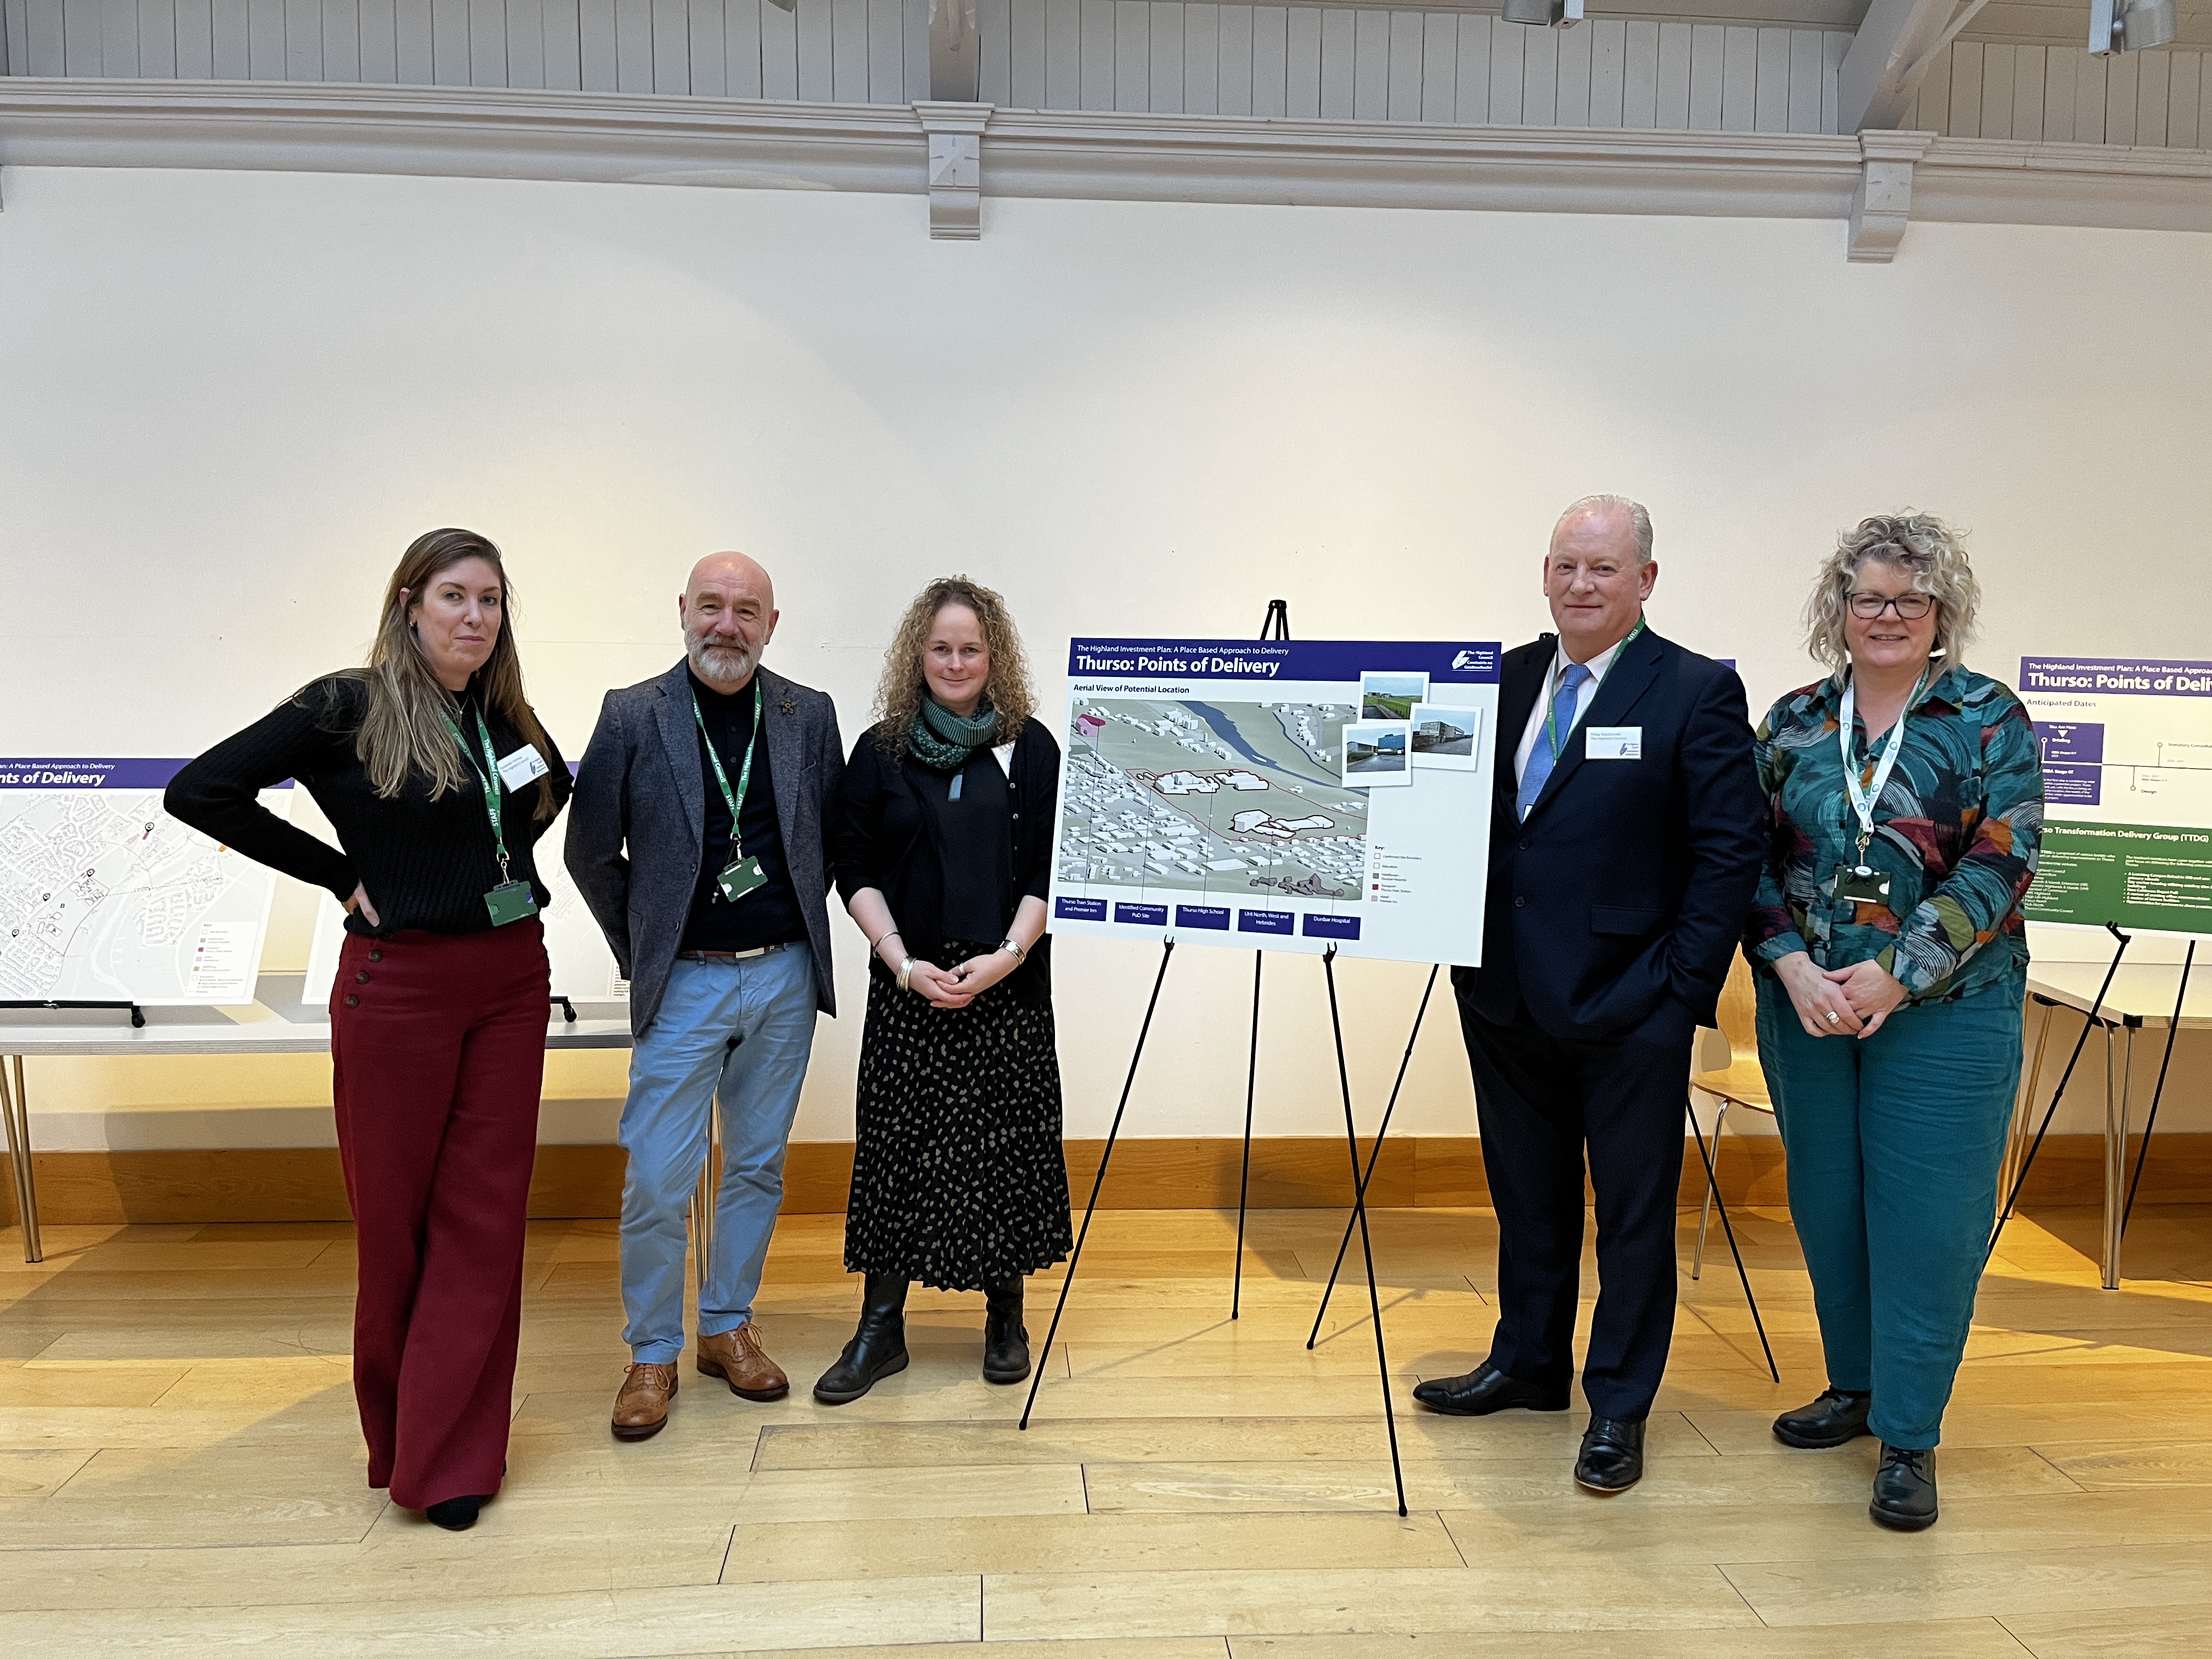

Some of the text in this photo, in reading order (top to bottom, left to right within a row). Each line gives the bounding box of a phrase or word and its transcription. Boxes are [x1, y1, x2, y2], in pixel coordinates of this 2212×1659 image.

[1627, 628, 1638, 642] STAFF
[1219, 647, 1252, 655] Approach
[1261, 647, 1289, 656] Delivery
[1076, 655, 1280, 678] Thurso: Points of Delivery
[2028, 672, 2212, 691] Thurso: Points of Deli
[485, 748, 498, 773] Highland
[741, 747, 753, 781] The Highland
[22, 771, 41, 783] of
[41, 771, 105, 787] Delivery
[715, 763, 726, 783] Council
[489, 808, 499, 826] STAFF
[2055, 826, 2116, 837] Transformation
[2118, 830, 2152, 840] Delivery
[2153, 832, 2179, 842] Group
[2180, 834, 2209, 843] (TTDG)
